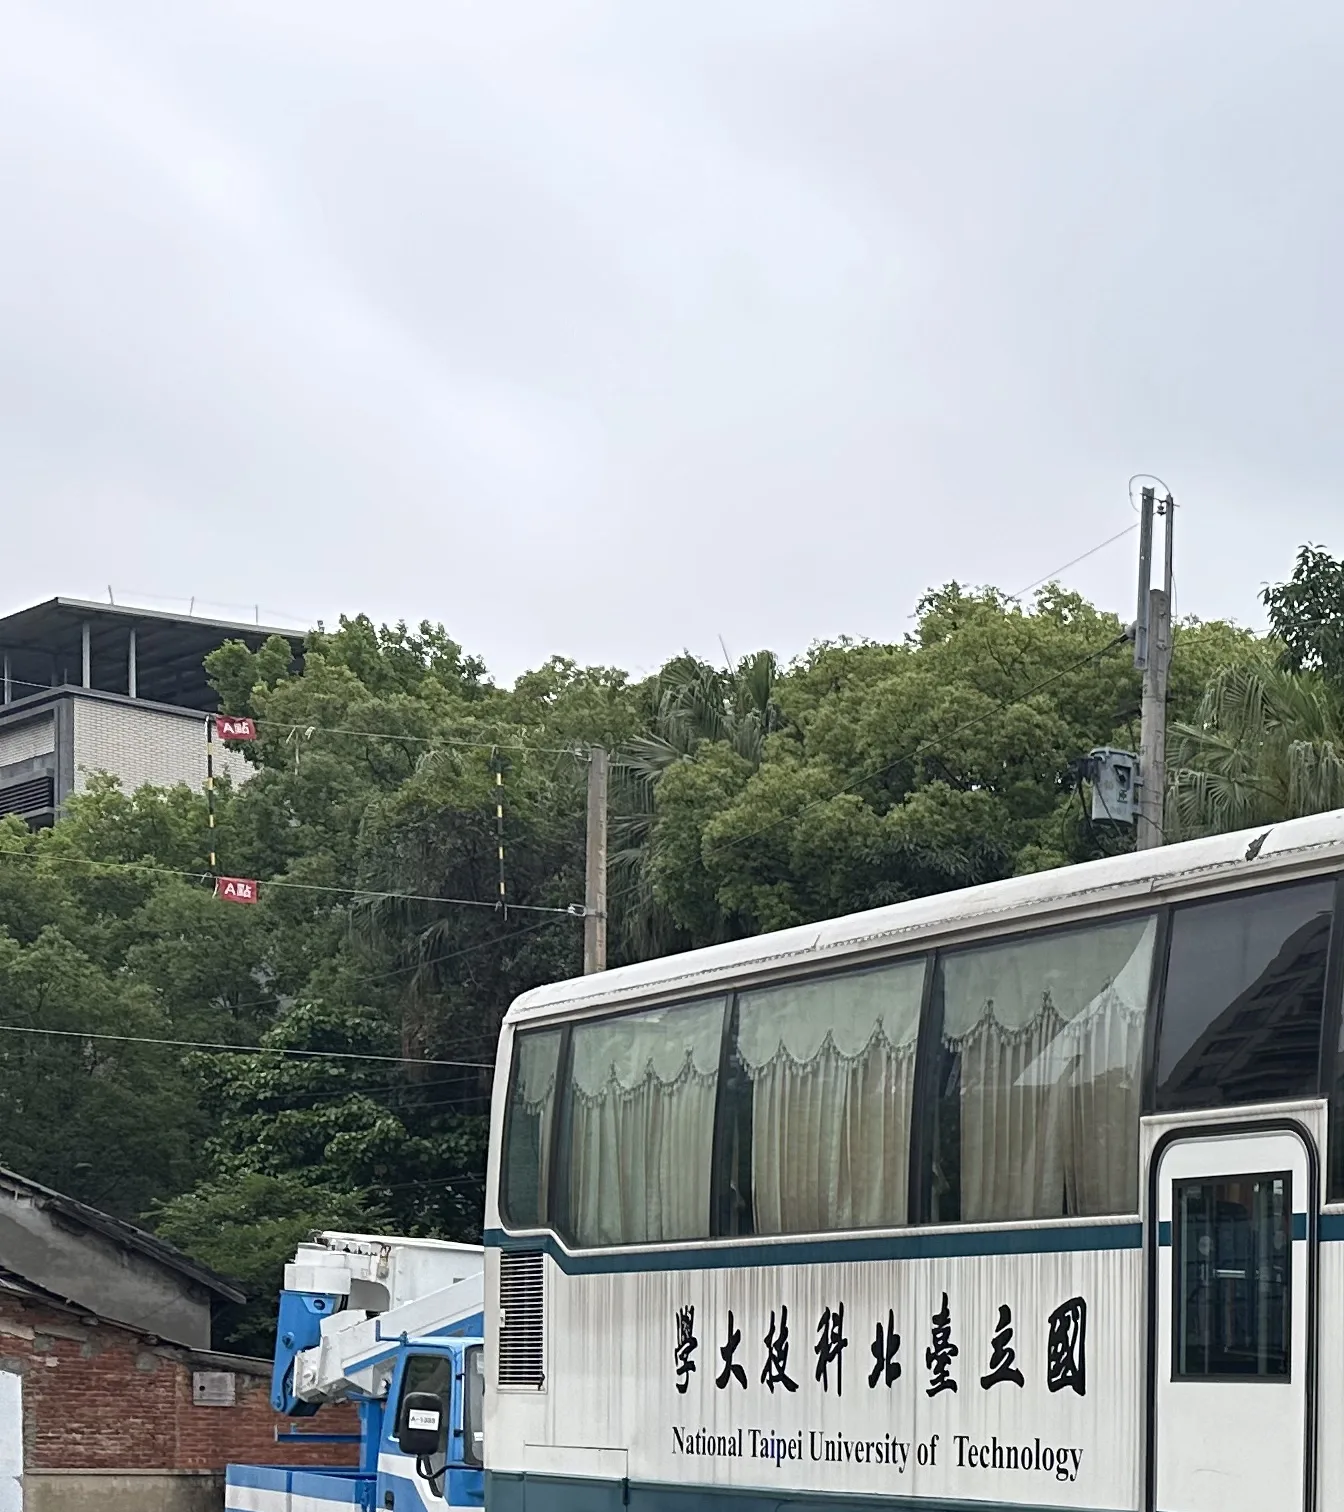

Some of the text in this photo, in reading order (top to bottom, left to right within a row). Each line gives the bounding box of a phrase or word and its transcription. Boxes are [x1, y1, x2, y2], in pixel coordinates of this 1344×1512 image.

[224, 882, 252, 899] A點
[671, 1425, 1084, 1483] National Taipei University of Technology
